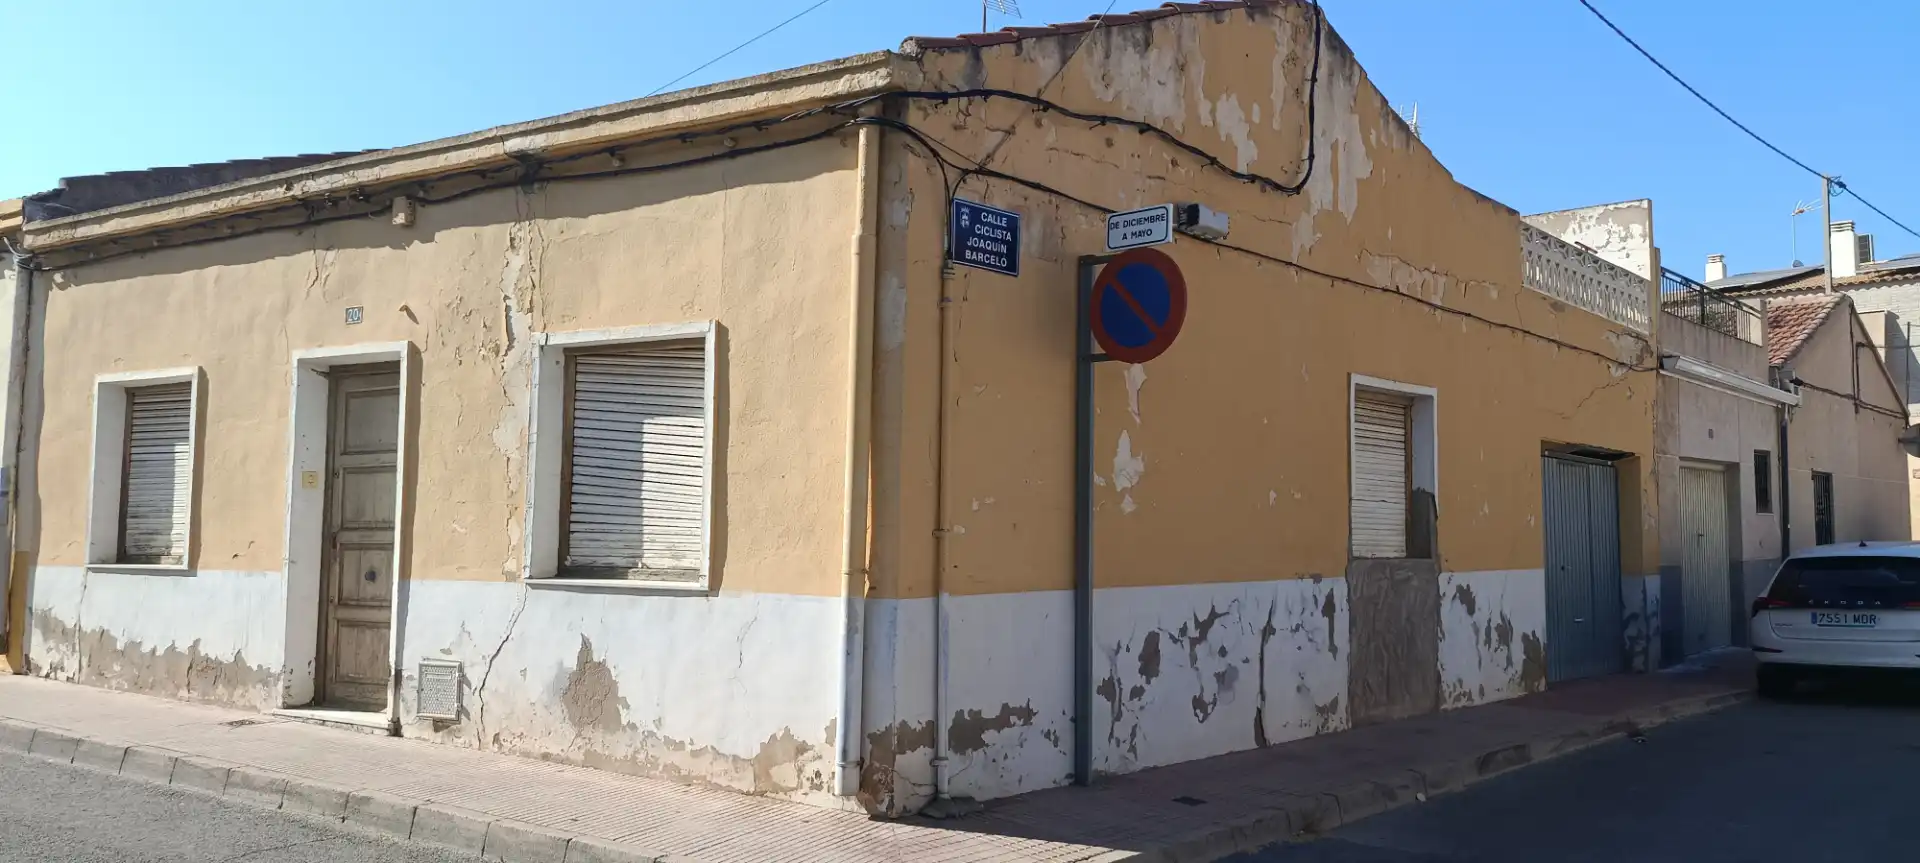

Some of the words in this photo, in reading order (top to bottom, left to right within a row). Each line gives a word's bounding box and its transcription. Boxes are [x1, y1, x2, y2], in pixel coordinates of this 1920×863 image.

[981, 212, 1007, 226] CALLE
[1110, 222, 1119, 230] DE
[1122, 213, 1166, 228] DICIEMBRE
[974, 224, 1012, 241] CICLISTA
[1121, 232, 1128, 241] A
[1130, 228, 1152, 240] MAYO
[967, 236, 1007, 253] JOAQUÍN
[965, 250, 1007, 267] BARCELÓ
[1819, 613, 1848, 624] 7551
[1853, 614, 1876, 624] MDR
